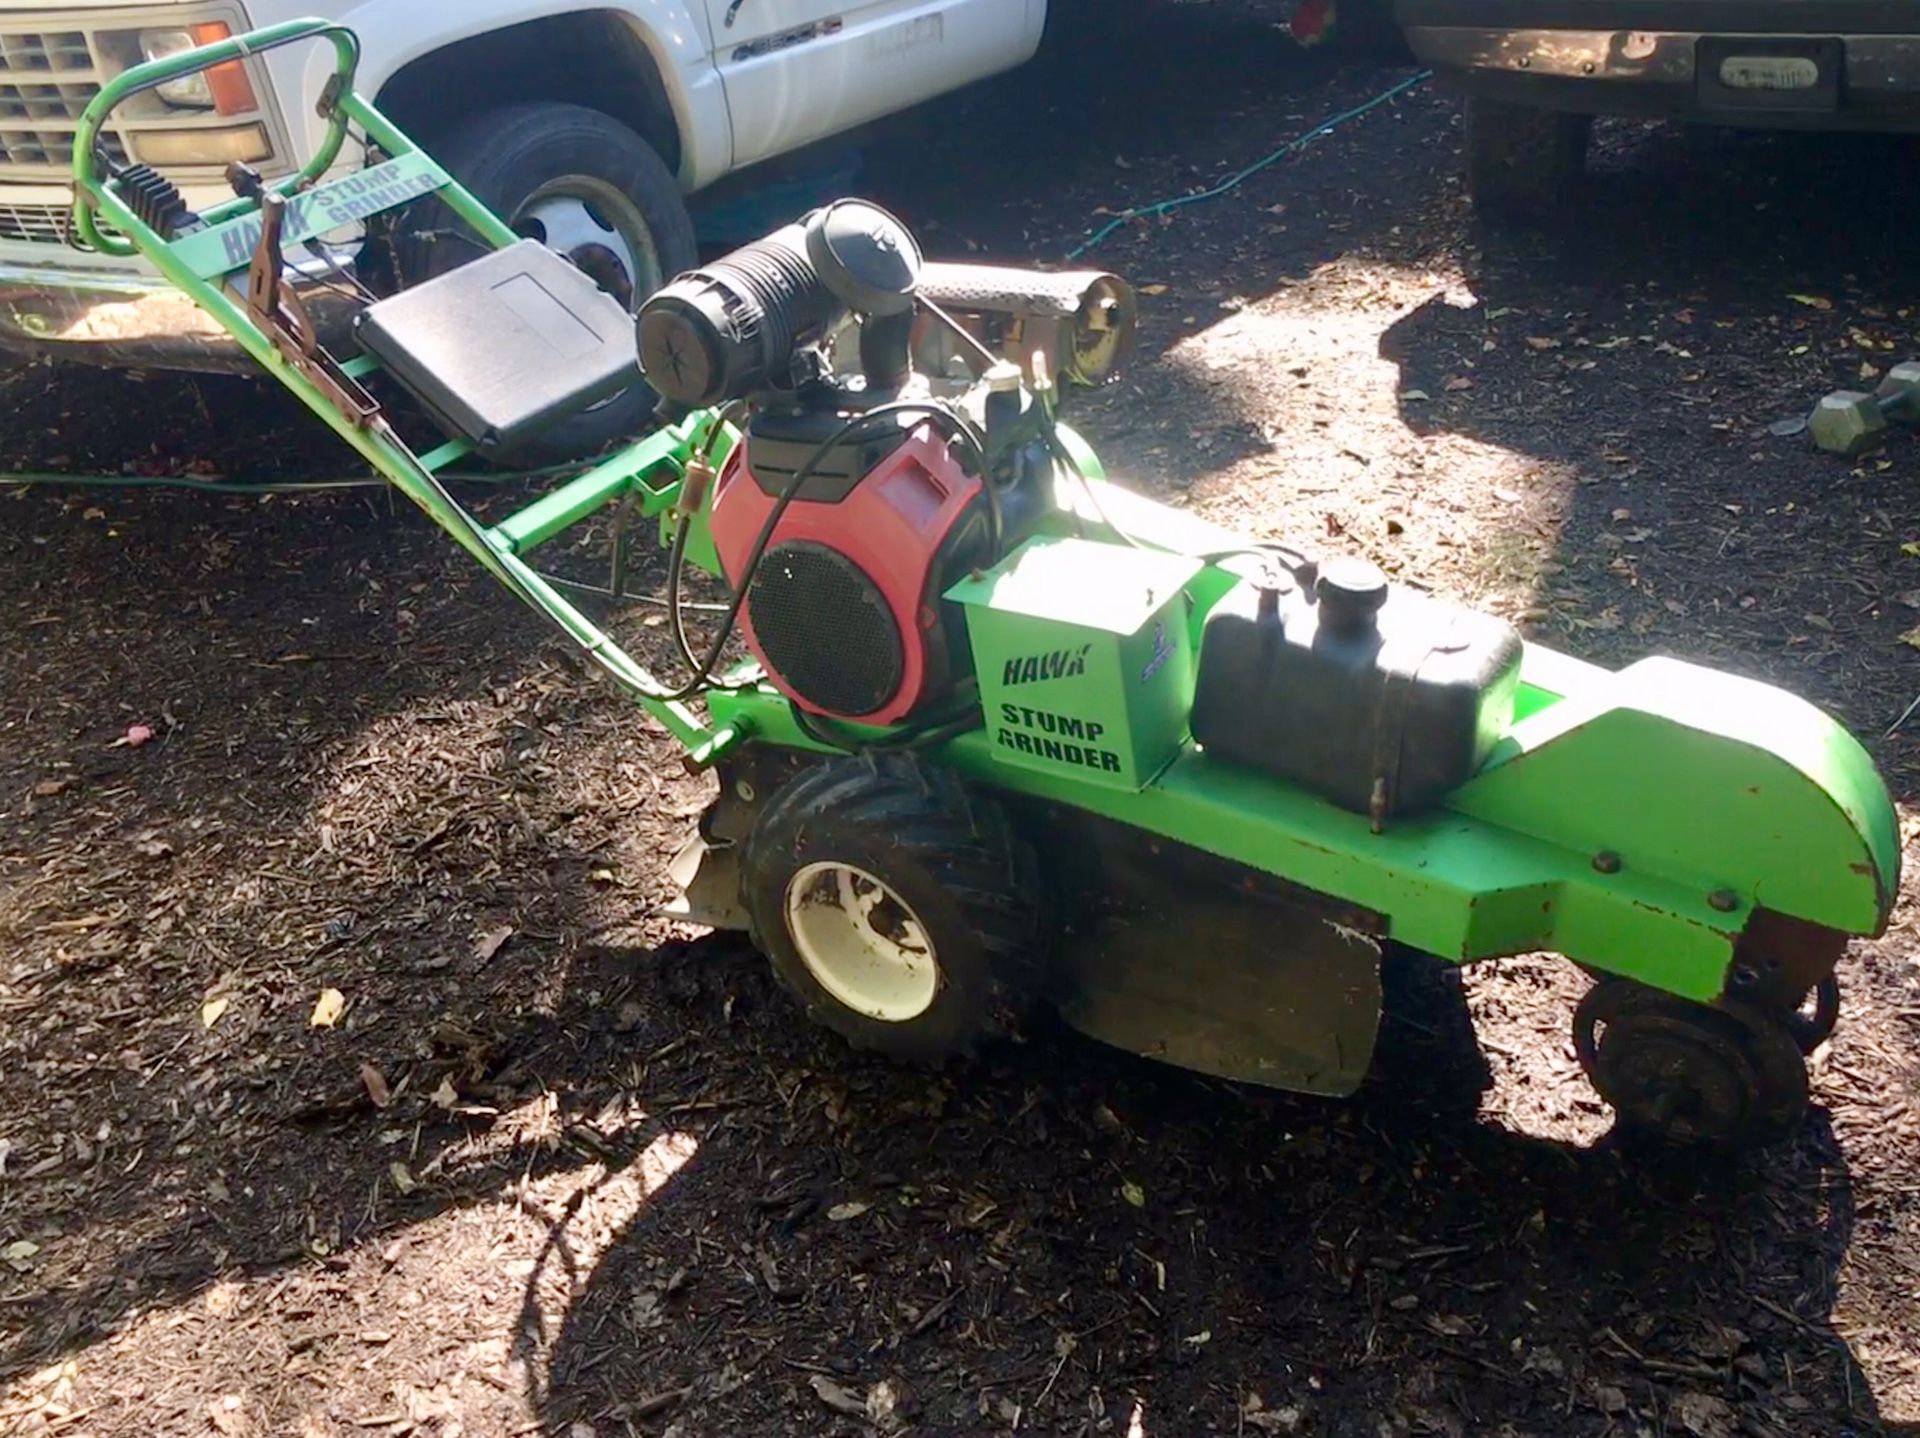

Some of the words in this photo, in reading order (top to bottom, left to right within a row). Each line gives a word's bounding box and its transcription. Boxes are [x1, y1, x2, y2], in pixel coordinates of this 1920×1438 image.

[311, 164, 400, 207] STUMP
[326, 173, 440, 223] GRINDER
[1003, 643, 1093, 686] HAWK
[1001, 703, 1104, 742] STUMP
[998, 728, 1121, 773] GRINDER
